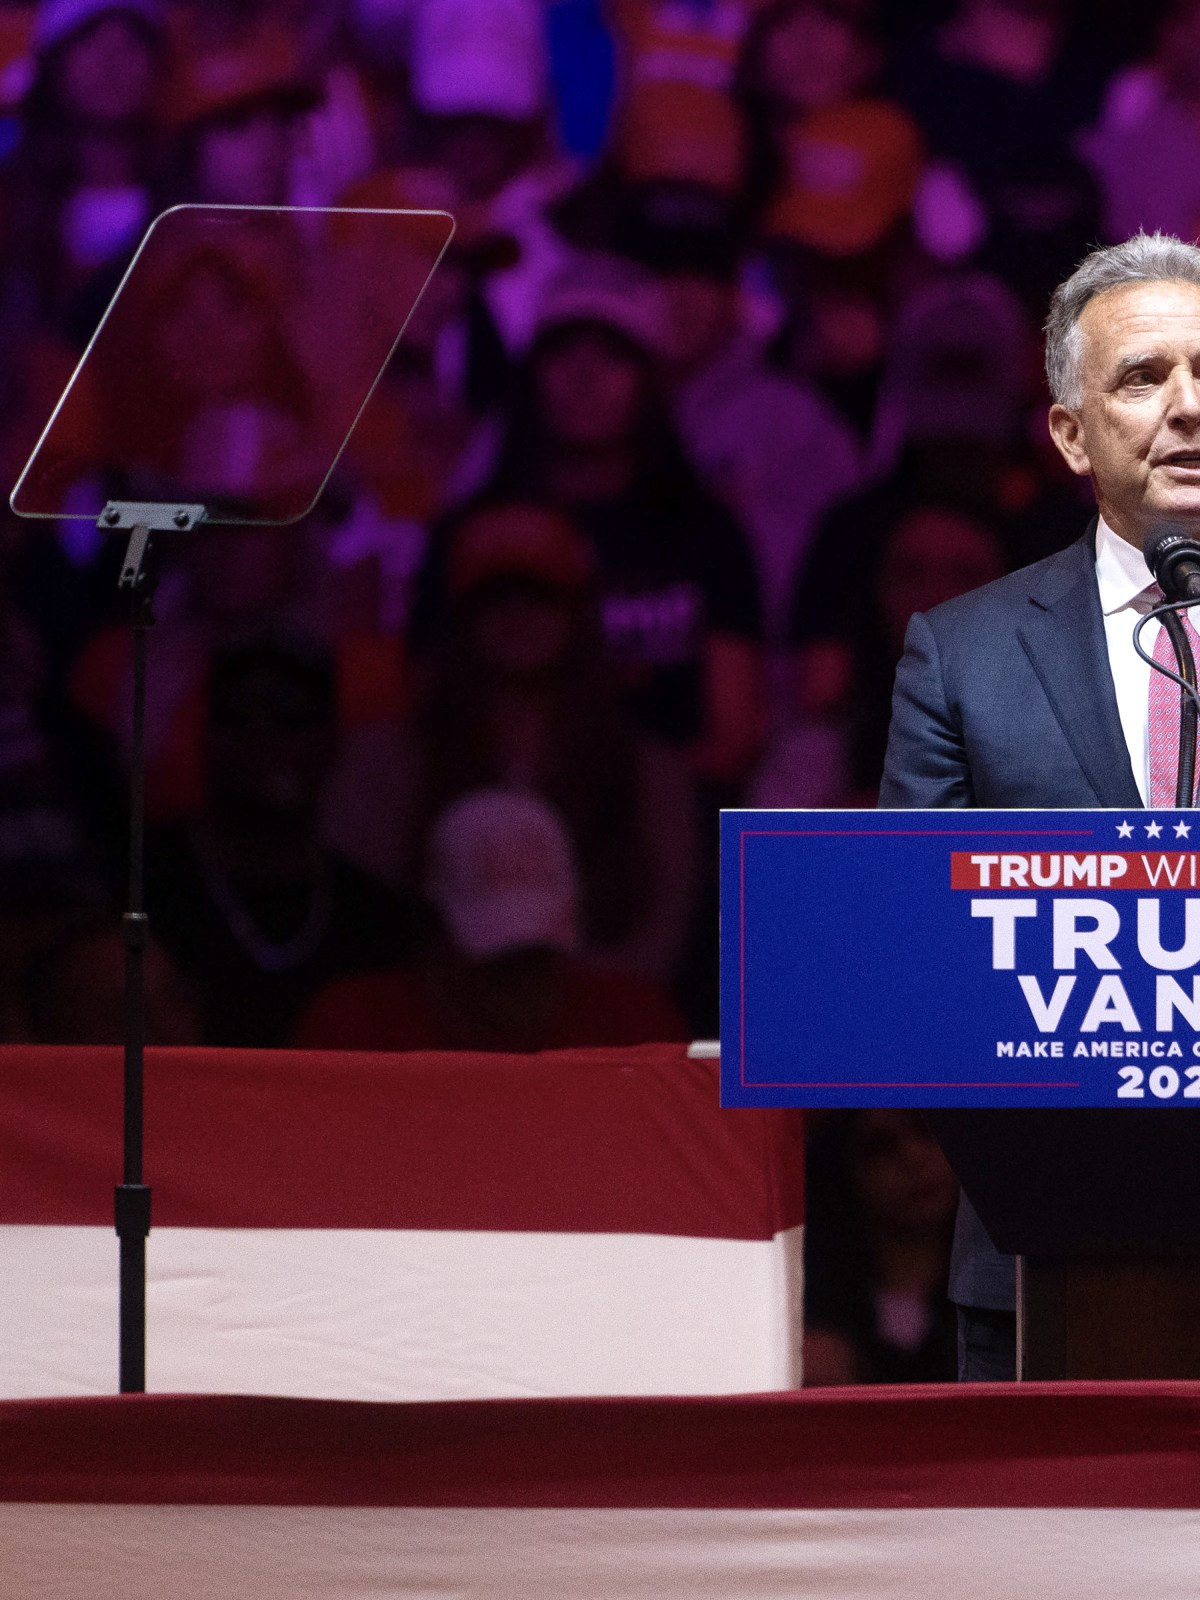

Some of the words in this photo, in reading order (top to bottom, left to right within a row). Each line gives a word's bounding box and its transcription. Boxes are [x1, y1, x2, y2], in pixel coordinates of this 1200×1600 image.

[970, 854, 1128, 888] TRUMP
[996, 1041, 1064, 1058] MAKE
[1073, 1040, 1183, 1058] AMERICA
